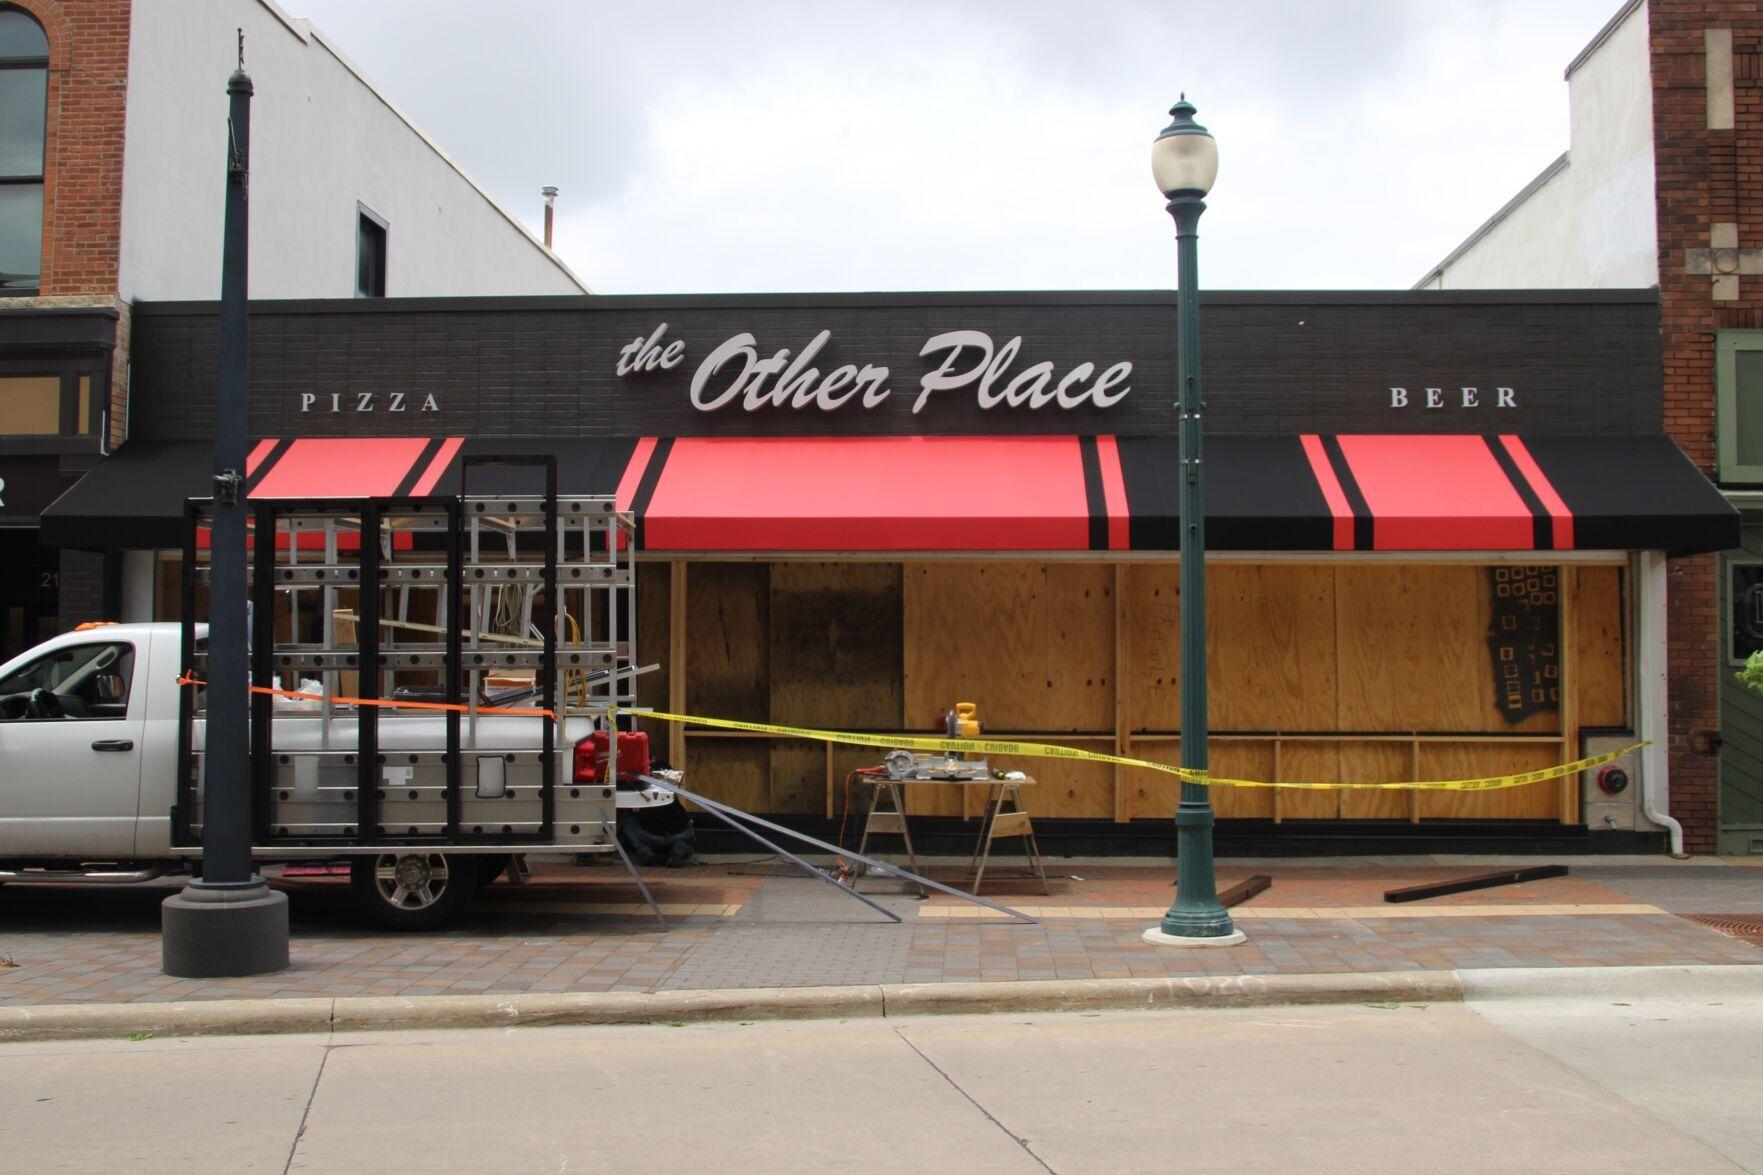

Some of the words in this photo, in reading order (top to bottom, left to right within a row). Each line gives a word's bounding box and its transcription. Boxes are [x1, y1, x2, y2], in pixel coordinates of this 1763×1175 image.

[616, 322, 686, 377] the
[690, 329, 891, 412] Other
[912, 330, 1133, 414] Place
[300, 392, 440, 412] PIZZA
[1389, 387, 1517, 408] BEER
